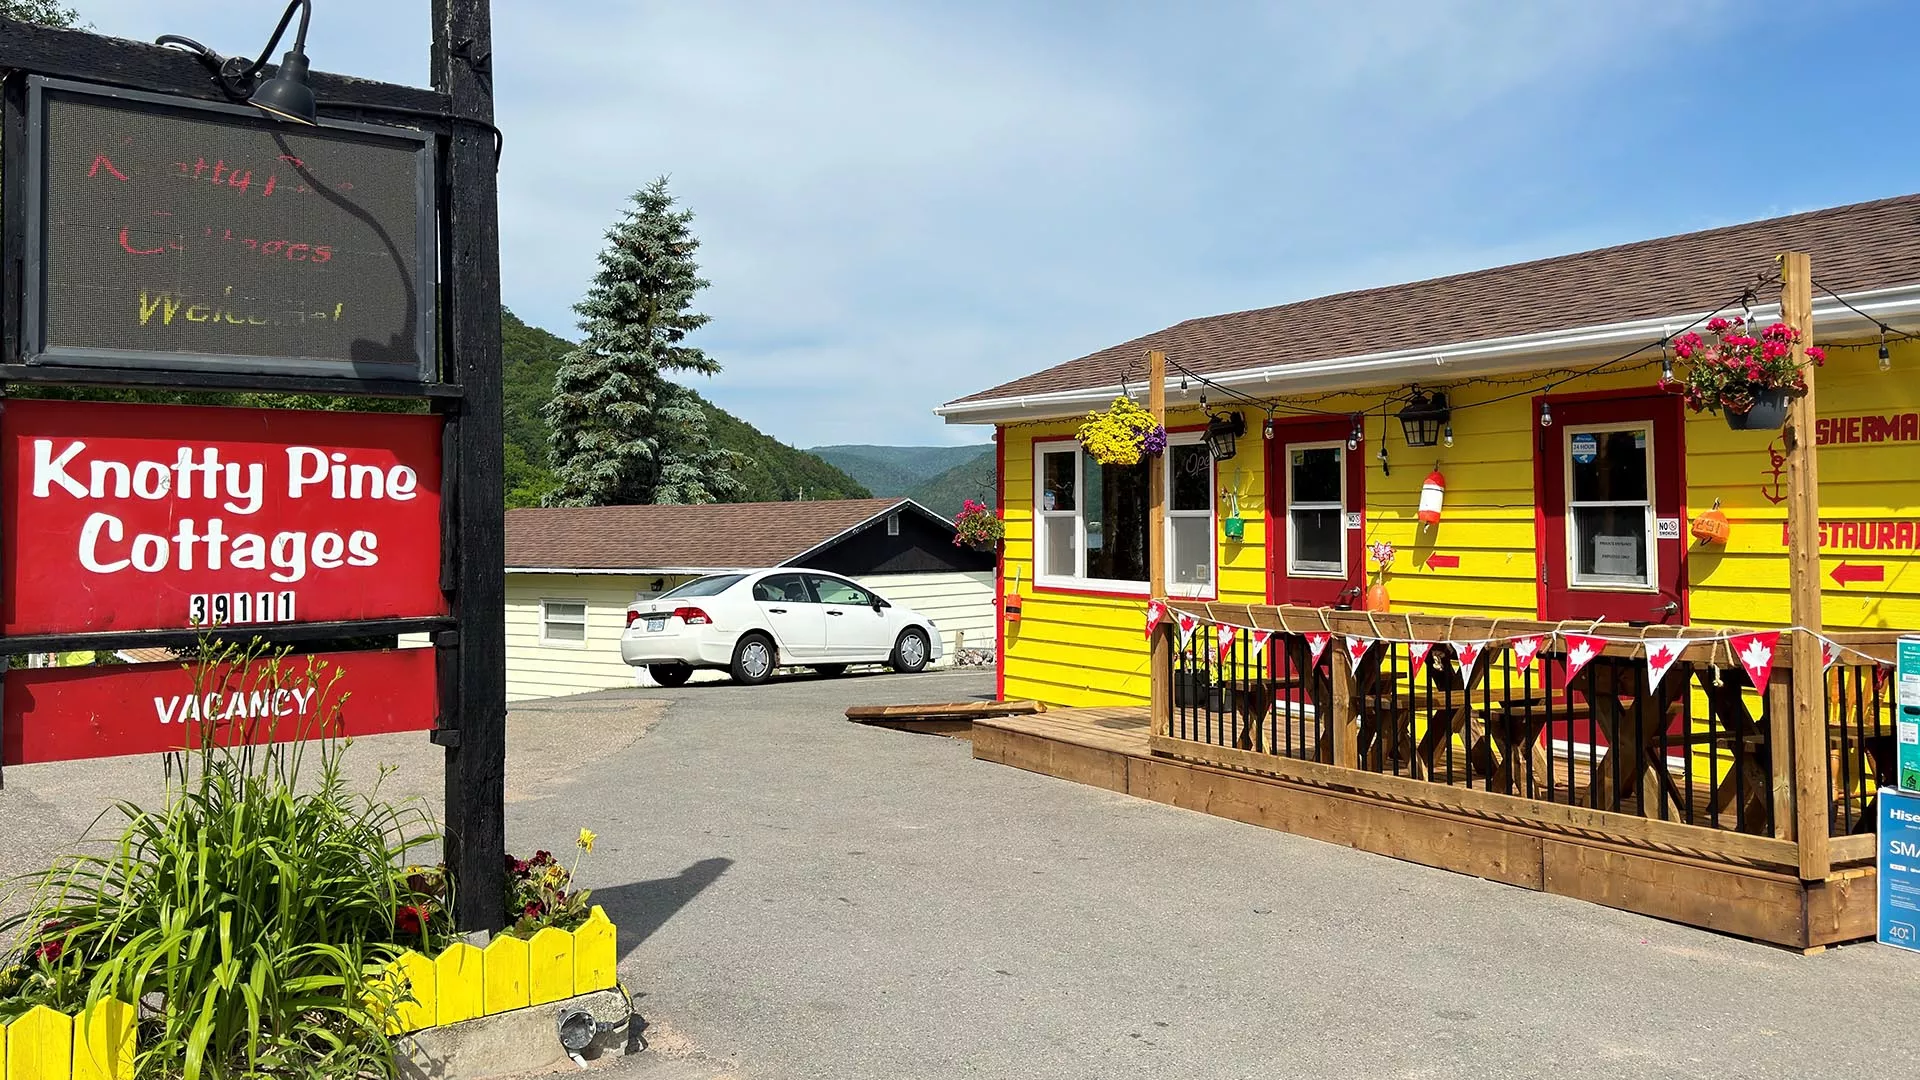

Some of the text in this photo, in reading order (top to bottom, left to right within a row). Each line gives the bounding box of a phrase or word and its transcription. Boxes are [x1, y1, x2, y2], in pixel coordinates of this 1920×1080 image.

[1816, 413, 1920, 445] SHERMA
[32, 439, 418, 515] Knotty Pine
[1659, 522, 1668, 530] NO
[1782, 521, 1920, 550] STAURA
[78, 512, 379, 583] Cottages
[193, 593, 290, 623] 39111
[153, 687, 317, 725] VACANCY
